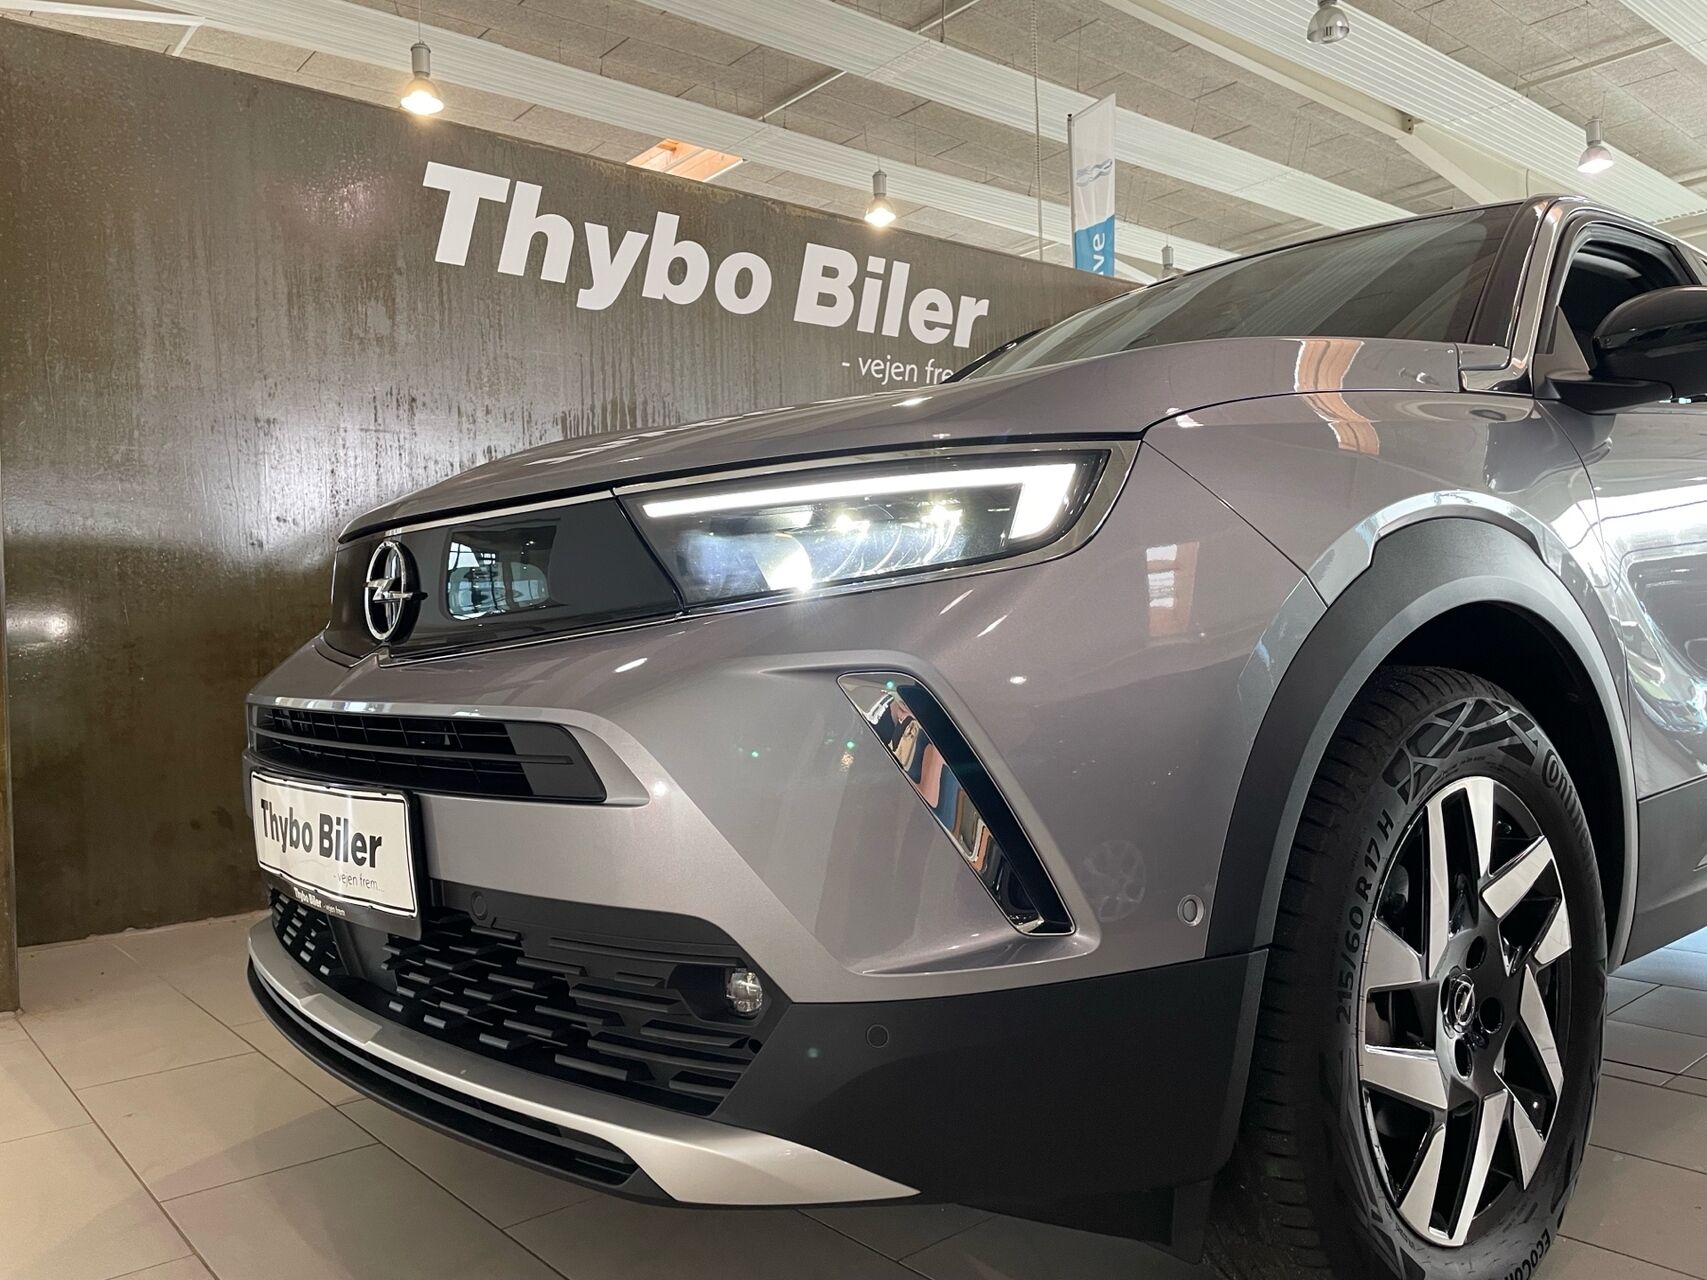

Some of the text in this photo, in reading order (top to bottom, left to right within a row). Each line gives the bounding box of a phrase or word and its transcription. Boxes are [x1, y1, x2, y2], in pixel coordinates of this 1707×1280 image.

[422, 161, 990, 348] Thybo Biler
[1092, 232, 1106, 276] ve
[858, 354, 918, 385] vejen
[261, 798, 382, 868] Thybo Biler
[1336, 905, 1364, 1025] 215/60
[1355, 875, 1373, 902] R
[1364, 837, 1381, 873] 17
[1376, 808, 1395, 841] H
